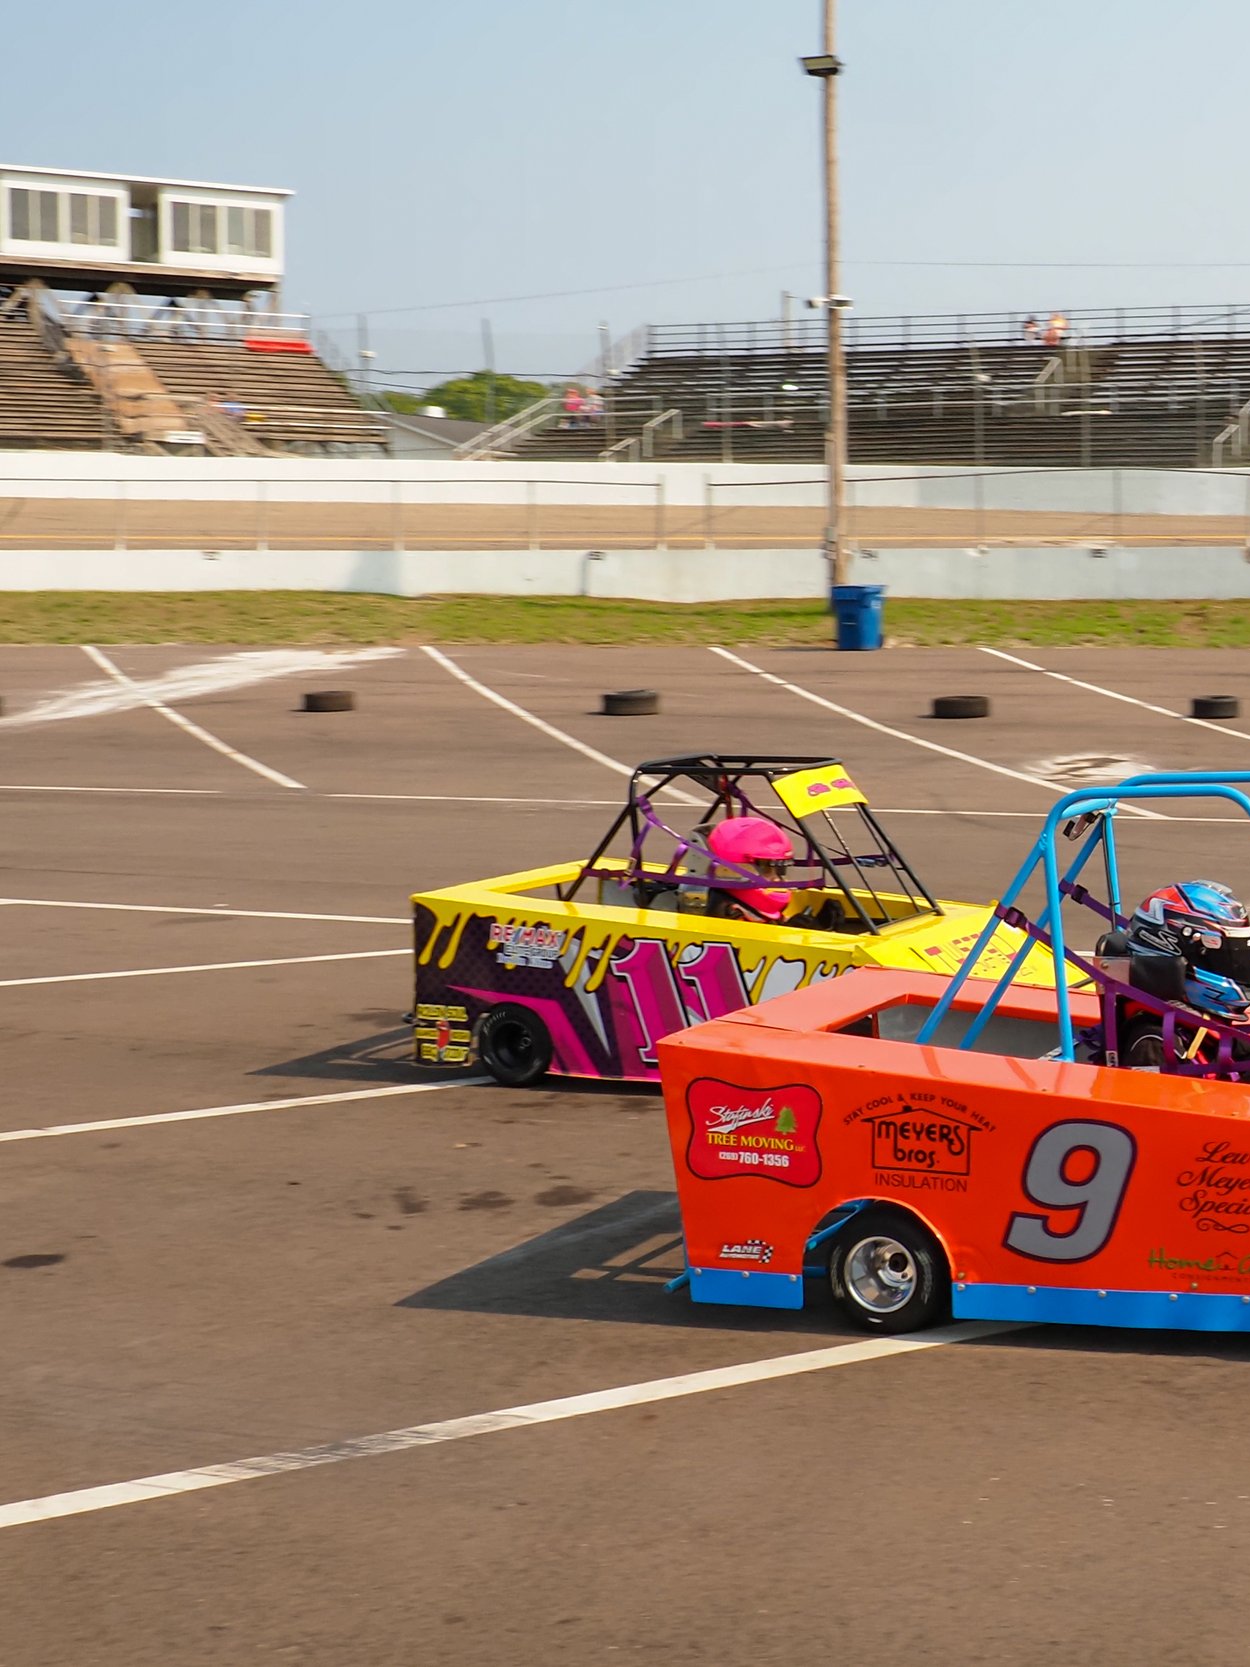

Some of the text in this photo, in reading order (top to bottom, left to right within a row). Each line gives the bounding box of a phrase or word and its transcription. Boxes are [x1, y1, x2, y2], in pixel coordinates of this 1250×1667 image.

[843, 1107, 864, 1126] STAY
[866, 1096, 893, 1110] COOL
[910, 1092, 936, 1102] KEEP
[941, 1096, 968, 1113] YOUR
[970, 1111, 997, 1132] HEAT
[706, 1133, 738, 1146] TREE
[741, 1136, 795, 1152] MOVING
[738, 1152, 790, 1168] 760-1356
[893, 1147, 941, 1169] bros.
[874, 1172, 968, 1193] INSULATION
[1003, 1118, 1138, 1265] 9
[722, 1244, 762, 1254] LANE
[1149, 1248, 1220, 1271] Home
